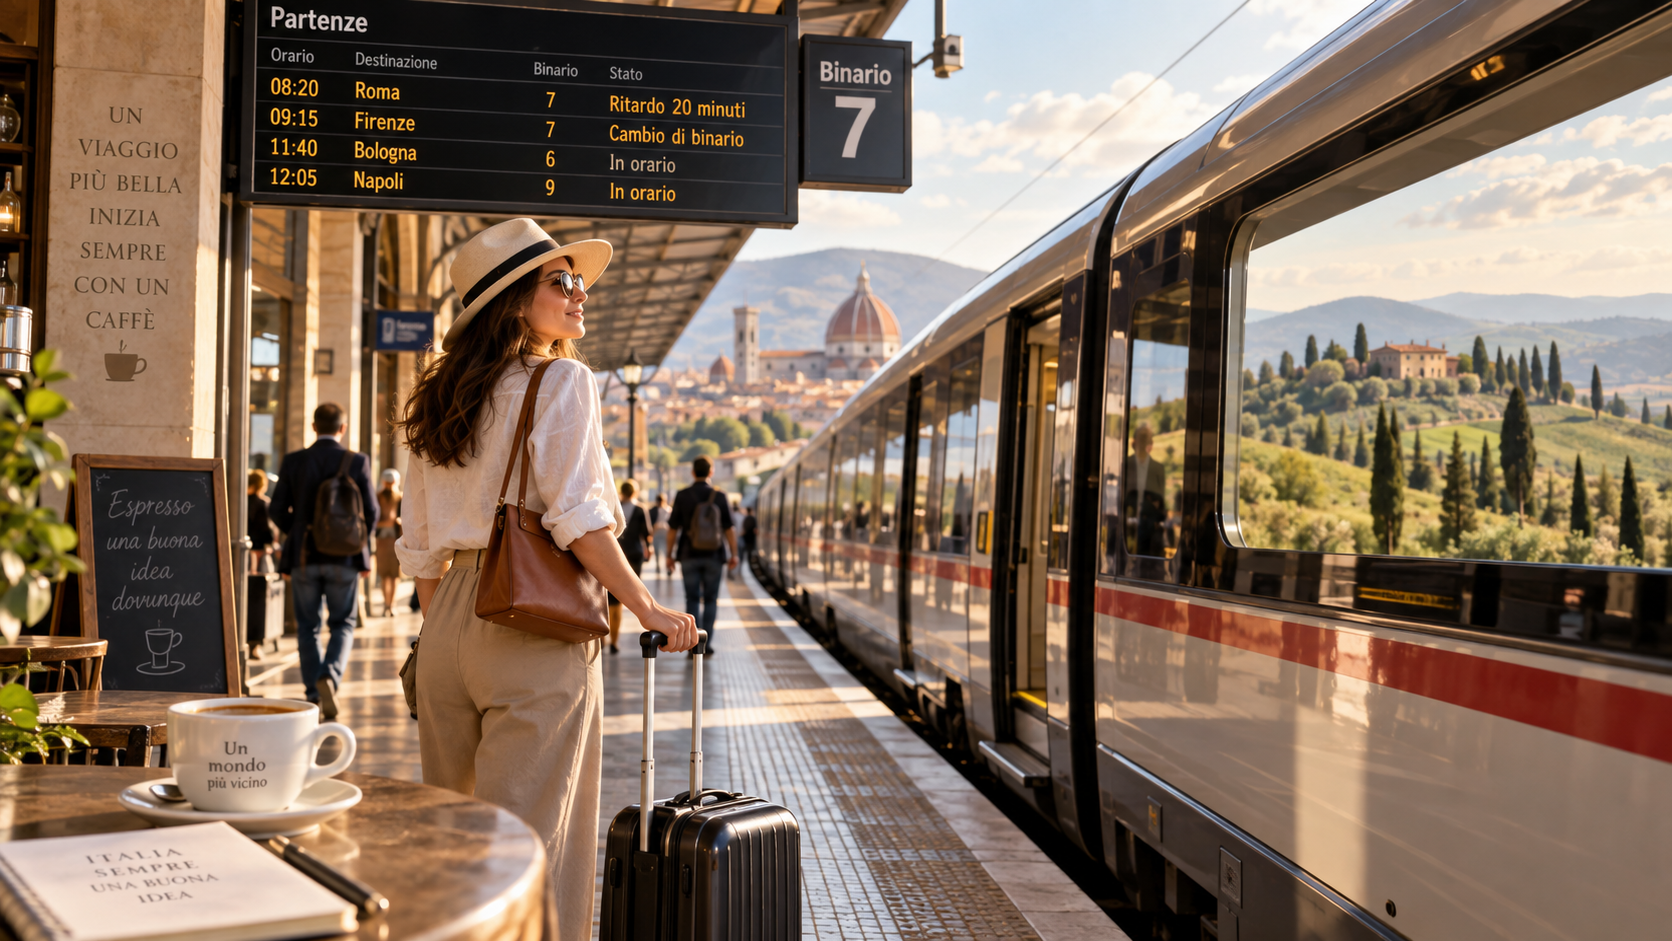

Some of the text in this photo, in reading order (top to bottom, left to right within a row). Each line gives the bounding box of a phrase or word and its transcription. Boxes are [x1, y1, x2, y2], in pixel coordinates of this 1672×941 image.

[271, 5, 368, 33] Partenze
[270, 47, 315, 64] Orario
[355, 51, 438, 70] Destinazione
[533, 61, 579, 78] Binario
[609, 66, 643, 81] Stato
[820, 60, 892, 86] Binario
[270, 77, 319, 97] 08:20
[355, 80, 400, 101] Roma
[546, 91, 556, 108] 7
[609, 94, 746, 119] Ritardo 20 minuti
[109, 106, 142, 124] UN
[270, 107, 318, 128] 09:15
[354, 111, 416, 132] Firenze
[546, 120, 556, 138] 7
[609, 124, 744, 148] Cambio di binario
[835, 95, 876, 159] 7
[78, 138, 179, 160] VIAGGIO
[270, 137, 318, 157] 11:40
[354, 140, 417, 165] Bologna
[545, 150, 556, 168] 6
[609, 153, 676, 174] In orario
[69, 168, 182, 194] PIÙ BELLA
[270, 167, 317, 187] 12:05
[353, 170, 404, 194] Napoli
[545, 178, 555, 196] 9
[610, 182, 676, 202] In orario
[89, 207, 161, 227] INIZIA
[80, 241, 166, 262] SEMPRE
[74, 276, 169, 296] CON UN
[85, 307, 155, 330] CAFFÈ
[108, 488, 195, 526] Espresso
[106, 525, 204, 551] una buona
[130, 555, 174, 581] idea
[111, 585, 206, 619] dovunque
[224, 741, 248, 756] Un
[208, 757, 266, 773] mondo
[85, 848, 182, 864] ITALIA
[94, 860, 199, 878] SEMPRE
[90, 873, 219, 893] UNA BUONA
[137, 890, 193, 904] IDEA
